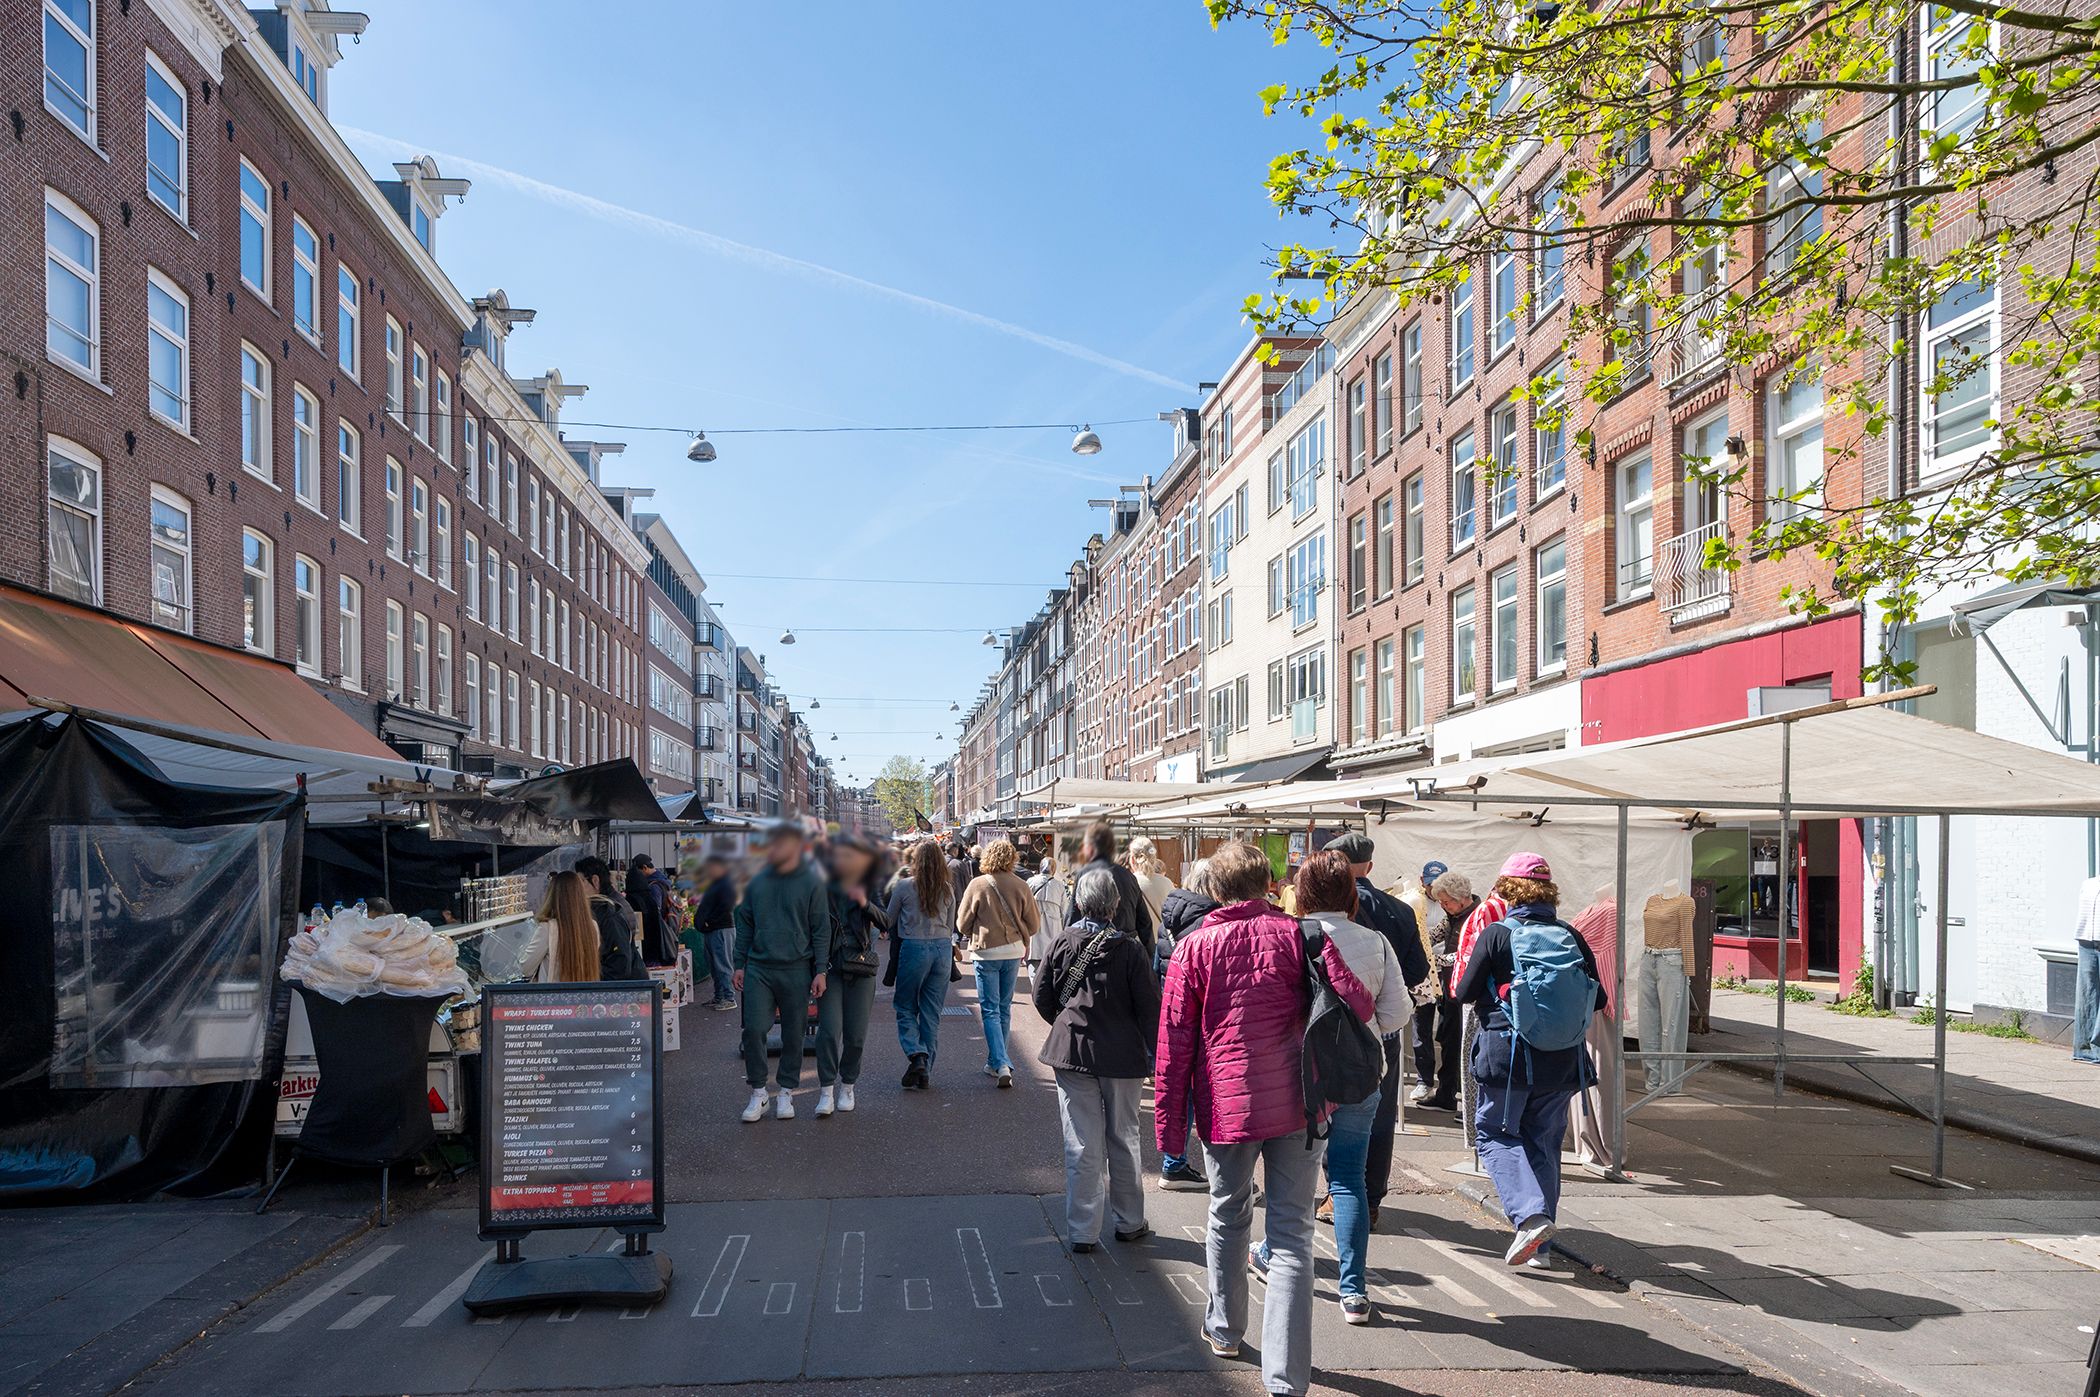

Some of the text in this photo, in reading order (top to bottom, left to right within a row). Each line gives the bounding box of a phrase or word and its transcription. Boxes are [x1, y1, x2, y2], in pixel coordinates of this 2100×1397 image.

[54, 883, 121, 922] INE'S
[550, 1008, 572, 1016] BROOD
[630, 1021, 641, 1030] 7,5
[630, 1038, 641, 1046] 7,5
[504, 1058, 526, 1066] TWINS
[630, 1054, 641, 1062] 7,5
[504, 1074, 533, 1082] HUMMUS
[630, 1070, 636, 1078] 6
[276, 1076, 318, 1096] arktt
[630, 1094, 636, 1102] 6
[630, 1111, 636, 1119] 6
[504, 1132, 521, 1140] AIOLI
[631, 1144, 642, 1152] 7,5
[504, 1150, 528, 1158] TURKSE
[631, 1168, 642, 1176] 2,5
[504, 1174, 528, 1182] DRINKS
[503, 1188, 523, 1196] EXTRA
